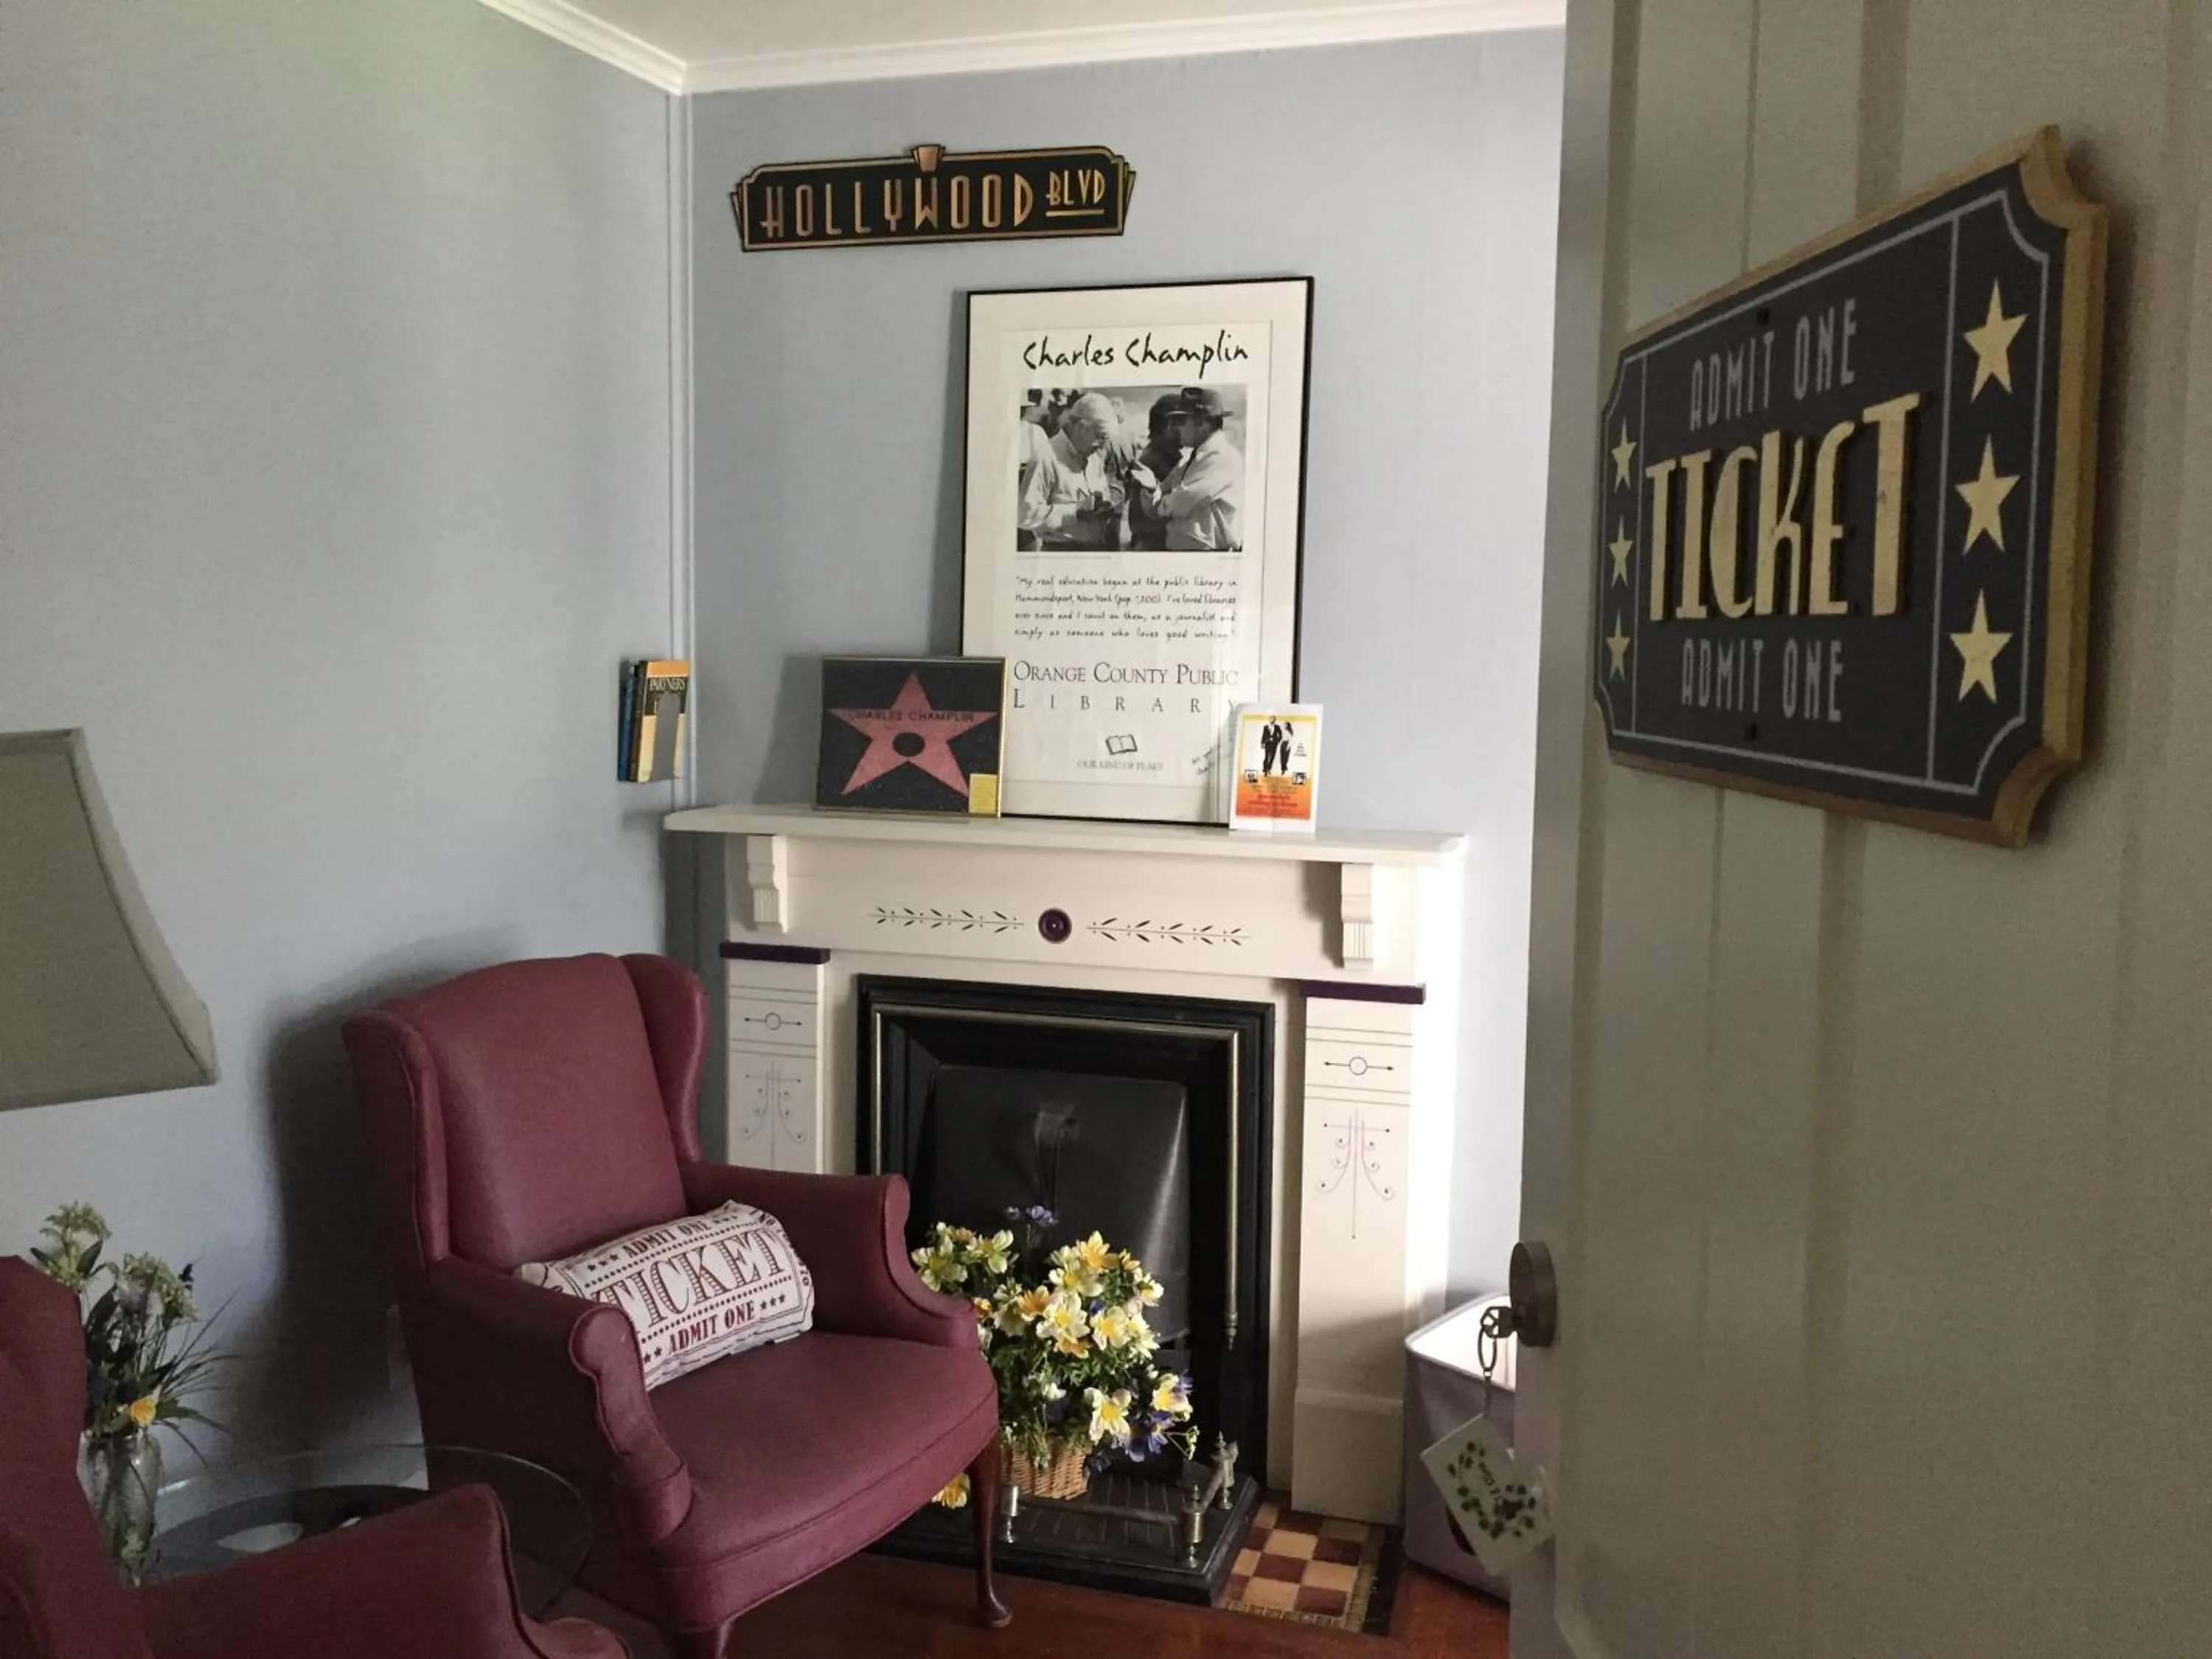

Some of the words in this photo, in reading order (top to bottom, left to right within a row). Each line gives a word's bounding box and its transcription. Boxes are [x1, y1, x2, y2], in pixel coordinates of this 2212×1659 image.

[760, 173, 1033, 238] HOLLYWOOD
[1046, 168, 1106, 207] BLVD
[1023, 333, 1115, 369] Charles
[1124, 329, 1249, 379] Champlin
[1689, 330, 1775, 431] ADMIT
[1793, 297, 1857, 400] ONE
[1645, 392, 1921, 622] TICKET
[1013, 660, 1086, 683] ORANGE
[1093, 661, 1169, 684] COUNTY
[1176, 663, 1239, 686] PUBLIC
[1680, 638, 1764, 714] ADMIT
[1781, 638, 1844, 723] ONE
[849, 709, 902, 721] CHARLES
[908, 709, 974, 722] CHAMPLIN
[622, 1229, 677, 1258] ADMIT
[668, 1312, 717, 1354] ADMIT
[723, 1299, 756, 1328] ONE
